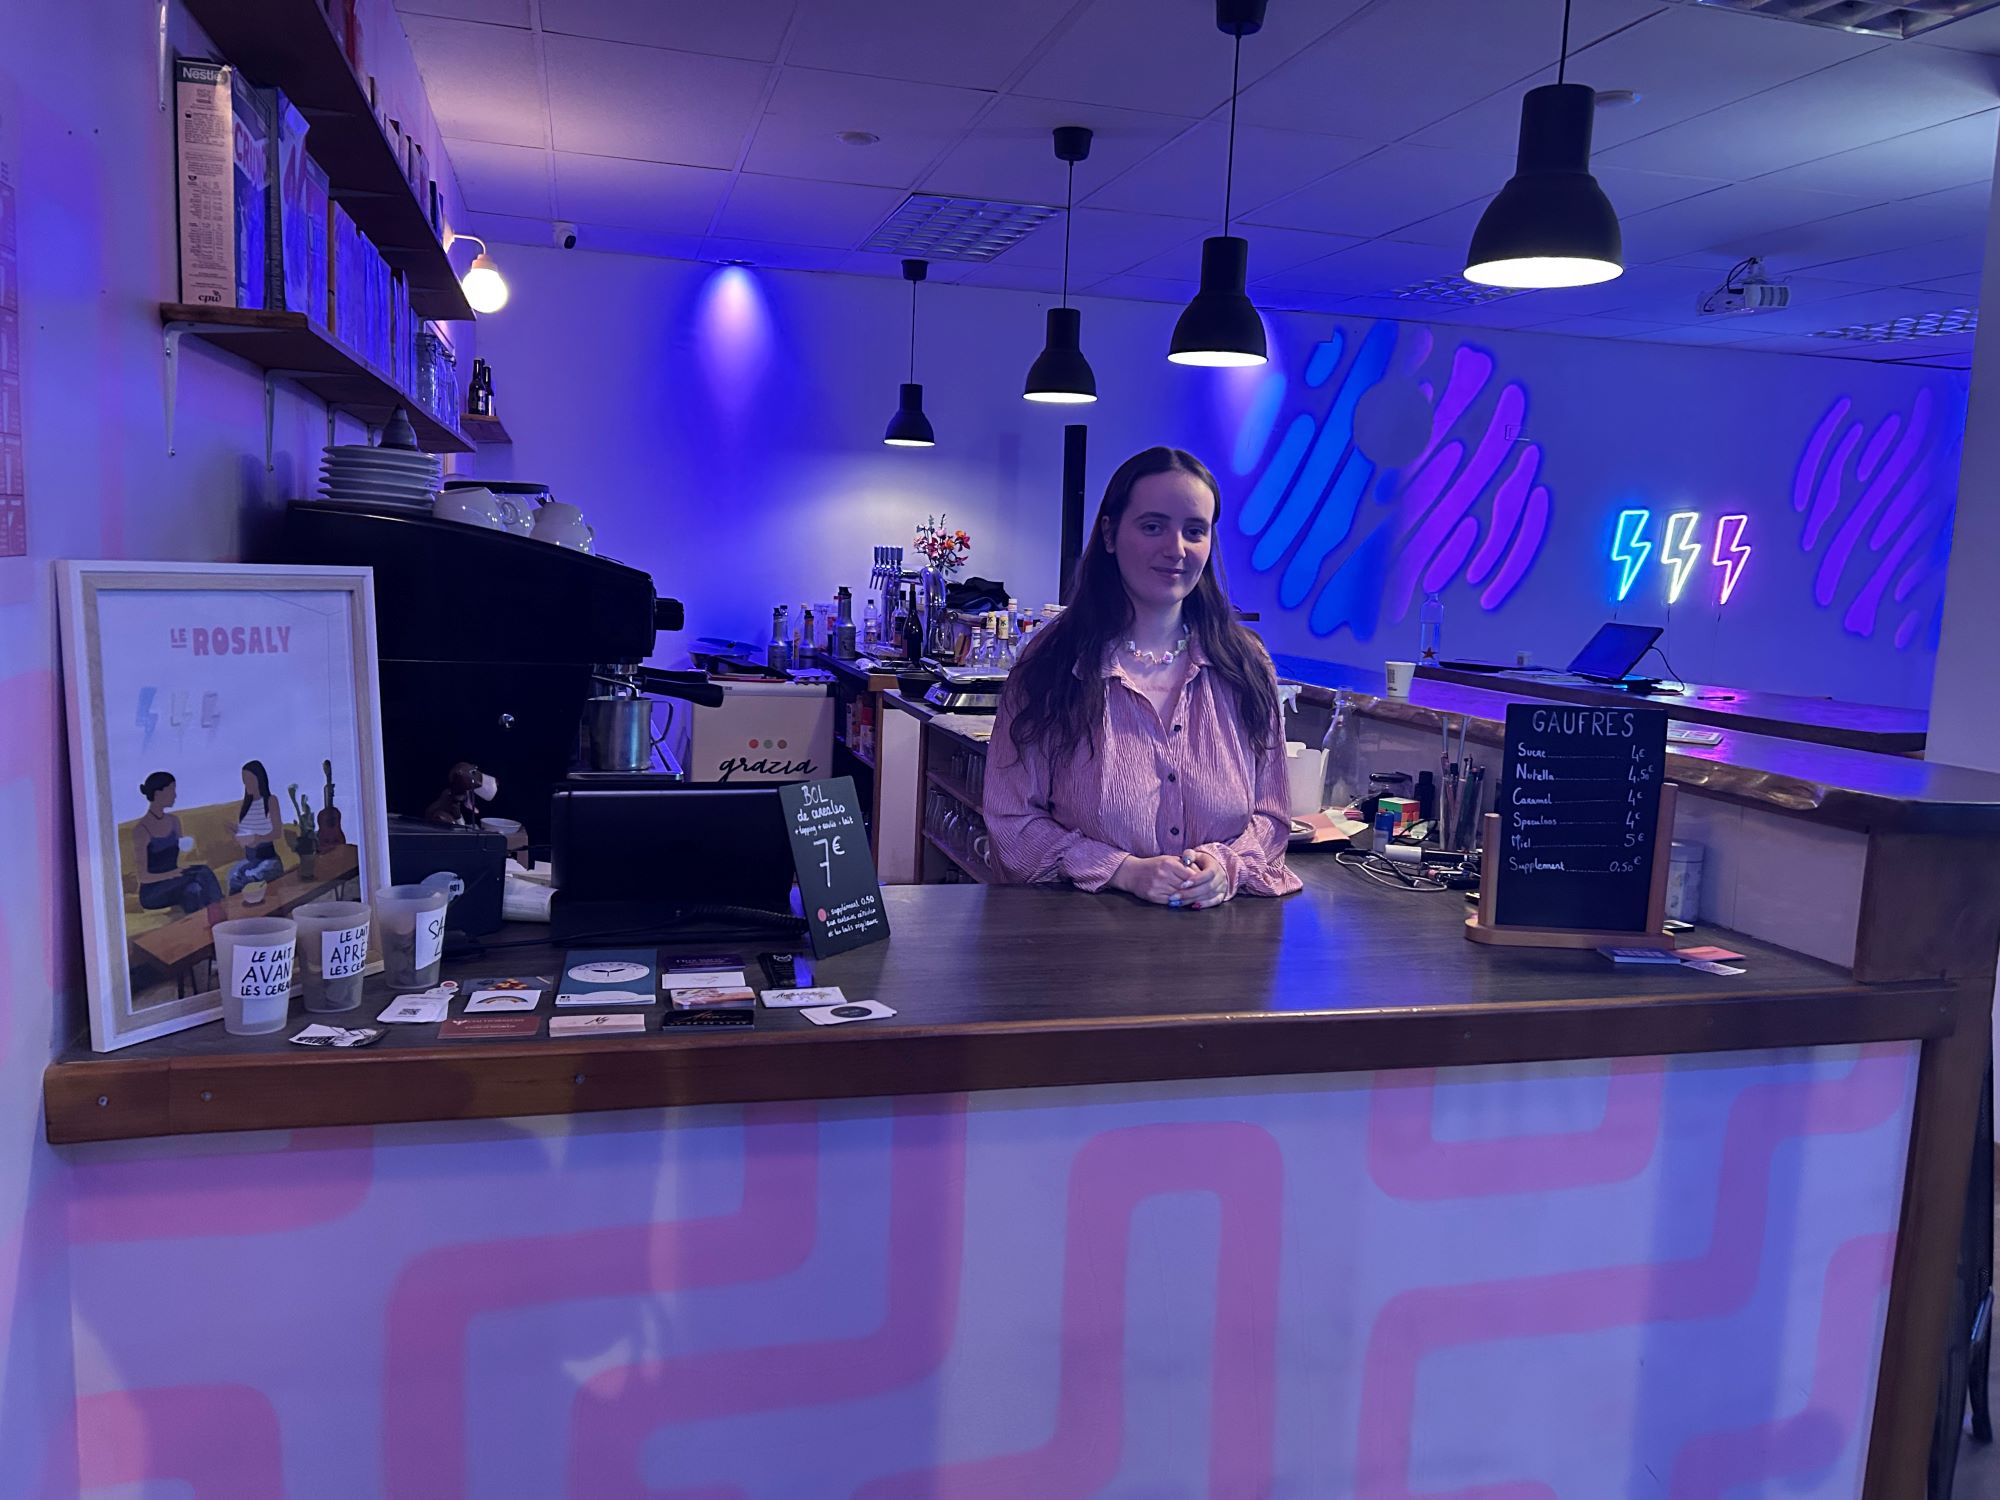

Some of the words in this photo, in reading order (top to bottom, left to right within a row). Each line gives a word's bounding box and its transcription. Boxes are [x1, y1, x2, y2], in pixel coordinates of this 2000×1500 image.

[170, 627, 187, 644] LE
[192, 625, 290, 656] ROSALY
[1532, 710, 1634, 737] GAUFRES
[1518, 742, 1547, 758] Sucre
[718, 757, 818, 783] grazia
[1516, 763, 1555, 781] Nutella
[801, 785, 829, 807] BOL
[1512, 787, 1552, 805] Caramel
[797, 808, 810, 822] de
[1513, 811, 1557, 830] Speculoos
[1511, 834, 1531, 850] Miel
[339, 931, 352, 944] LE
[355, 926, 369, 940] LAIT
[251, 950, 267, 963] LE
[271, 947, 292, 963] LAIT
[330, 939, 366, 964] APRÈ
[241, 962, 291, 984] AVAN
[330, 965, 349, 976] LES
[240, 985, 261, 997] LES
[265, 981, 291, 996] CEREA
